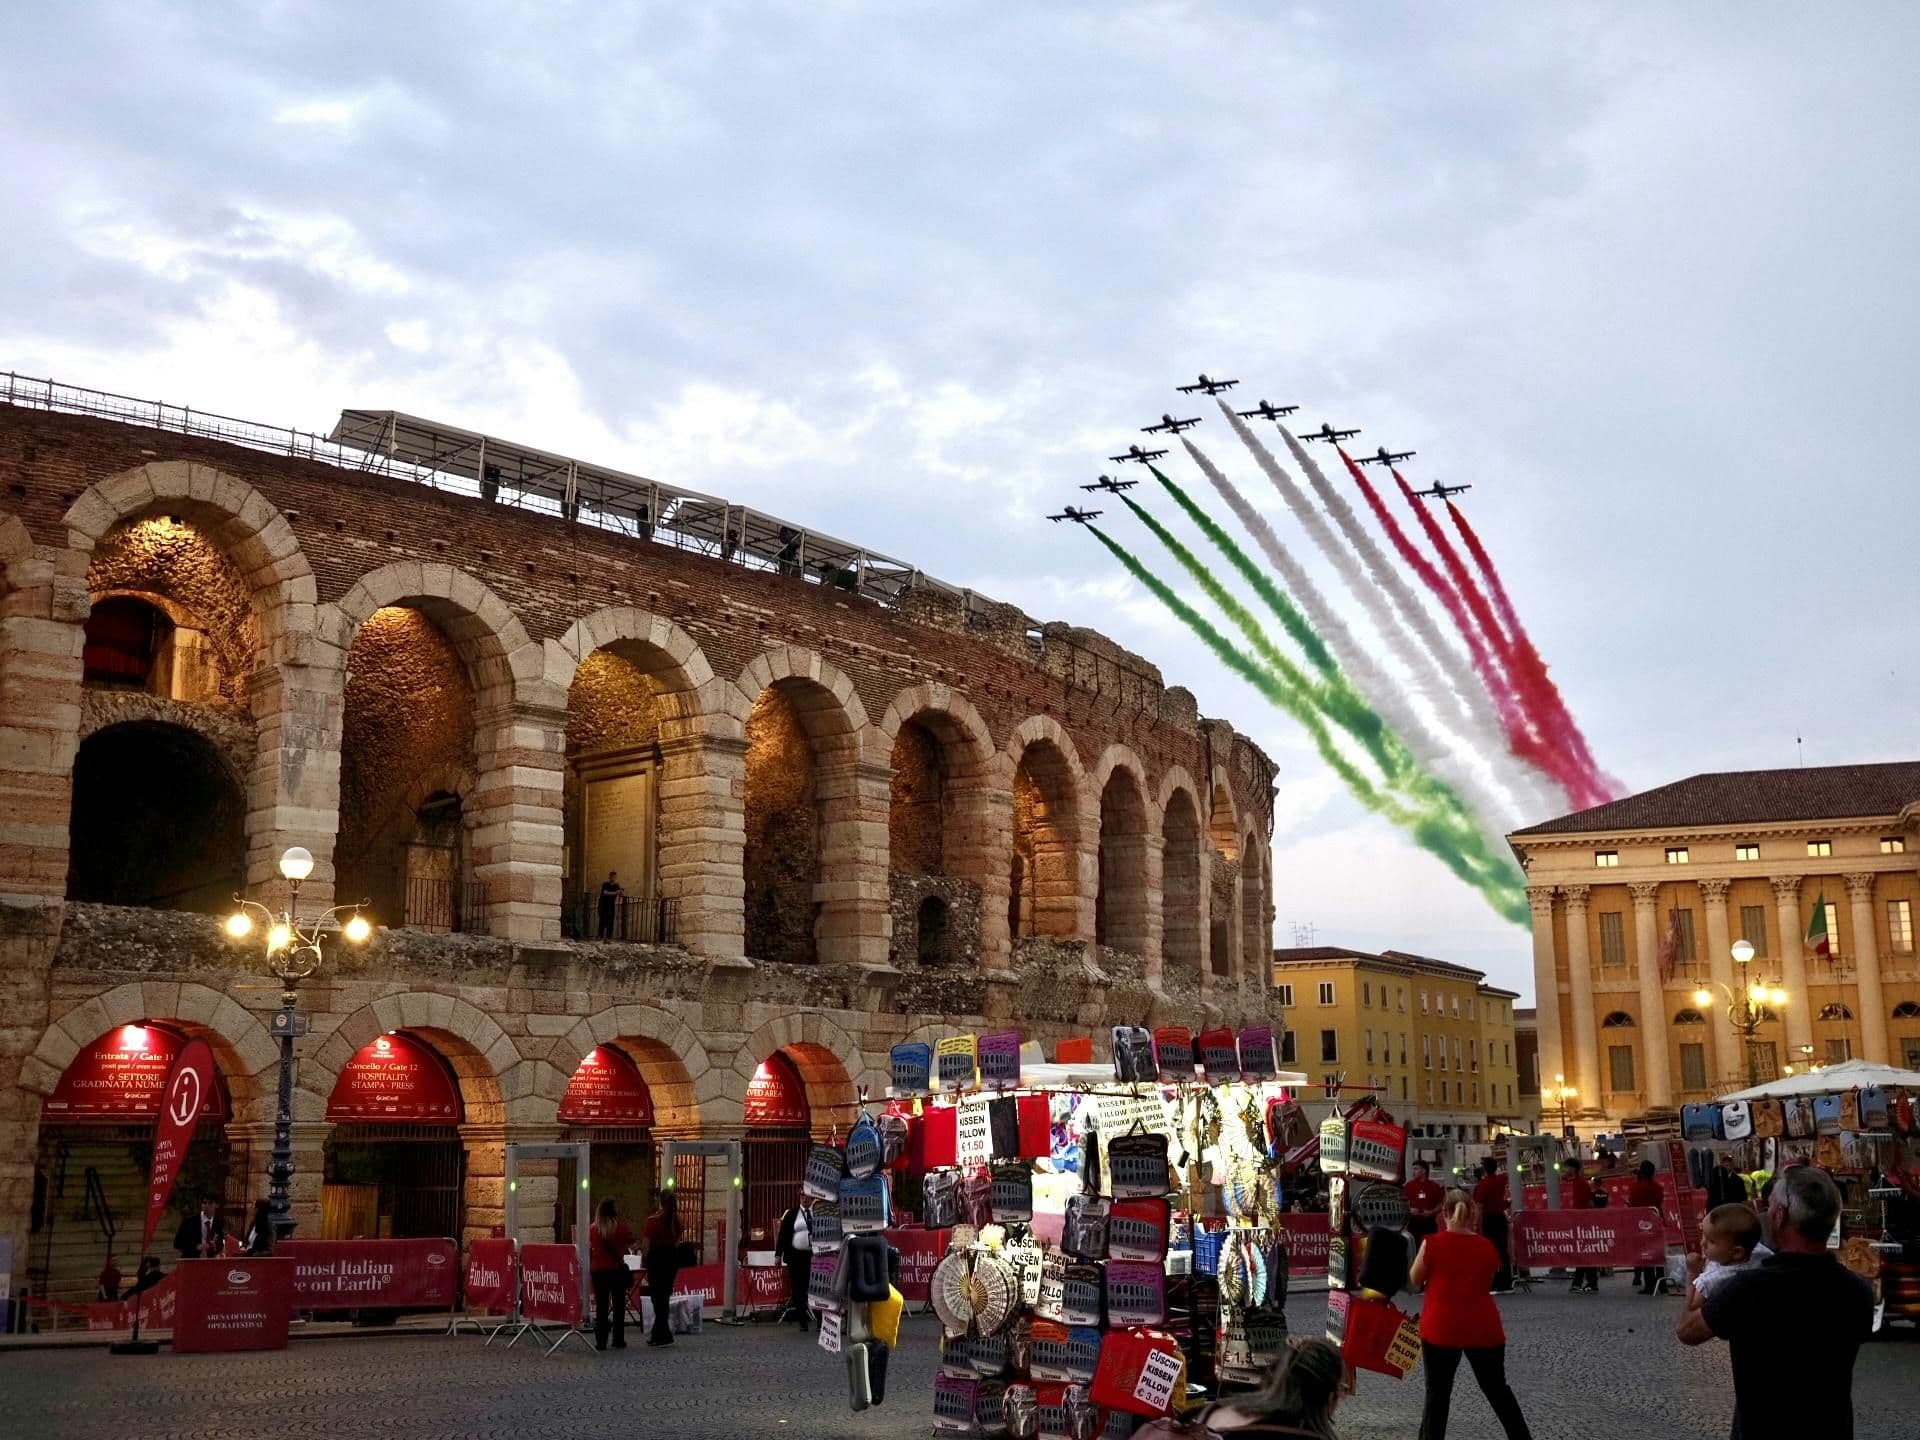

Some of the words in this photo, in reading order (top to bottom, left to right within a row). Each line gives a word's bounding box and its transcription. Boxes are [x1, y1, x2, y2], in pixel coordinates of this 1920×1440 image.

[95, 1052, 129, 1060] Entrata
[140, 1052, 163, 1061] Gate
[346, 1062, 381, 1071] Cancello
[389, 1063, 408, 1071] Gate
[410, 1063, 418, 1071] 12
[118, 1072, 160, 1081] SETTORE
[357, 1072, 410, 1081] HOSPITALITY
[72, 1080, 133, 1089] GRADINATA
[135, 1080, 166, 1089] NUME
[351, 1081, 385, 1090] STAMPA
[391, 1082, 415, 1090] PRESS
[1097, 1099, 1126, 1109] KISSEN
[1143, 1103, 1162, 1112] OPERA
[959, 1115, 985, 1126] KISSEN
[960, 1128, 986, 1139] PILLOW
[1360, 1168, 1382, 1179] Verona
[853, 1222, 873, 1230] Verona
[1524, 1227, 1545, 1240] The
[1547, 1229, 1574, 1241] most
[1577, 1225, 1616, 1240] Italian
[1010, 1238, 1041, 1249] CUSCIN
[1527, 1240, 1558, 1258] place
[1560, 1243, 1574, 1254] on
[1122, 1251, 1145, 1260] Verona
[1292, 1243, 1328, 1257] Festiv
[916, 1250, 938, 1267] Italia
[1043, 1252, 1066, 1267] CUSCI
[296, 1264, 336, 1277] most
[340, 1260, 393, 1275] Italian
[915, 1267, 931, 1284] Ear
[1042, 1269, 1064, 1281] KISSE
[311, 1281, 331, 1292] on
[671, 1284, 716, 1300] inArena
[1040, 1284, 1062, 1299] PILLO
[1121, 1315, 1145, 1323] Verona
[1392, 1343, 1417, 1361] PILLOW
[1150, 1352, 1180, 1372] CUSCINI
[1146, 1364, 1174, 1383] KISSEN
[1141, 1376, 1170, 1395] PILLOW
